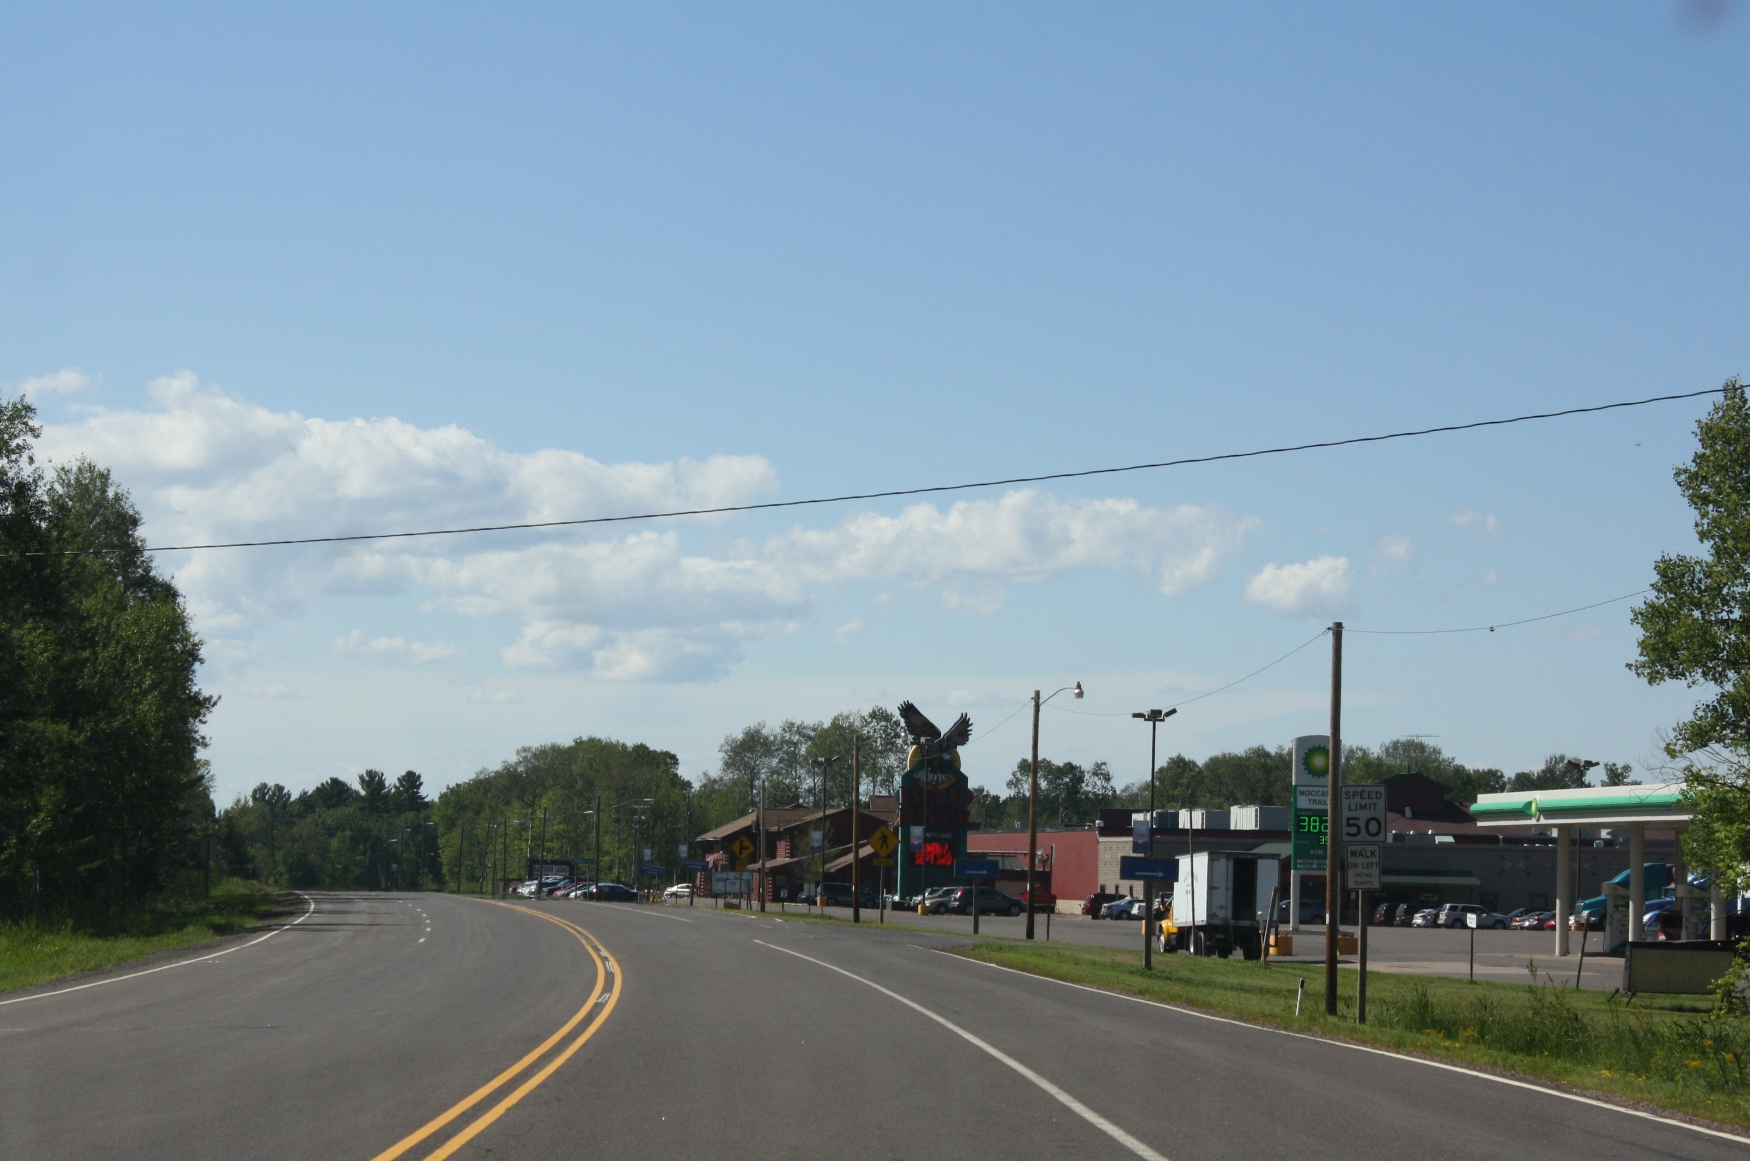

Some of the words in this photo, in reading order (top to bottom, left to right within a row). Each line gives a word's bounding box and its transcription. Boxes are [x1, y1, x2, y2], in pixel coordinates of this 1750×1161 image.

[1298, 789, 1329, 797] MOCCAS
[1344, 790, 1383, 800] SPEED
[1308, 798, 1329, 806] TRAIL
[1348, 802, 1378, 812] LIMIT
[1345, 816, 1382, 838] 50
[1350, 849, 1377, 858] WALK
